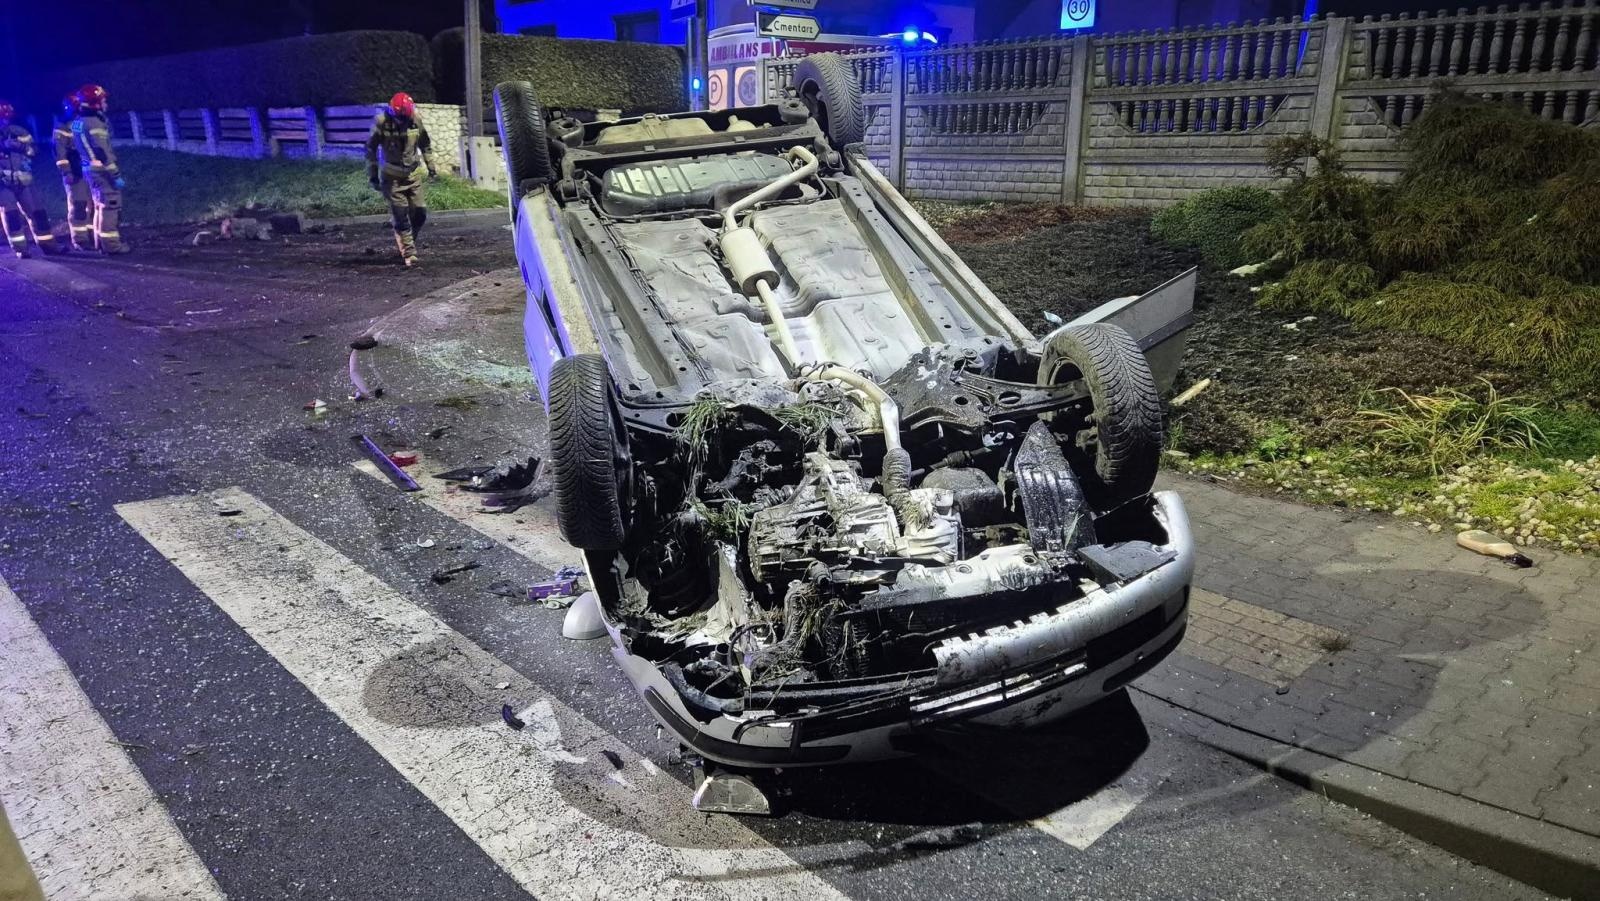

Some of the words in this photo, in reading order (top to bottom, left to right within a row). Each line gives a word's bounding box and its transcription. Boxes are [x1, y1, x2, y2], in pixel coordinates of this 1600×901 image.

[1071, 1, 1087, 14] 30
[773, 20, 813, 34] Cmentarz
[710, 42, 758, 61] AMBULANS
